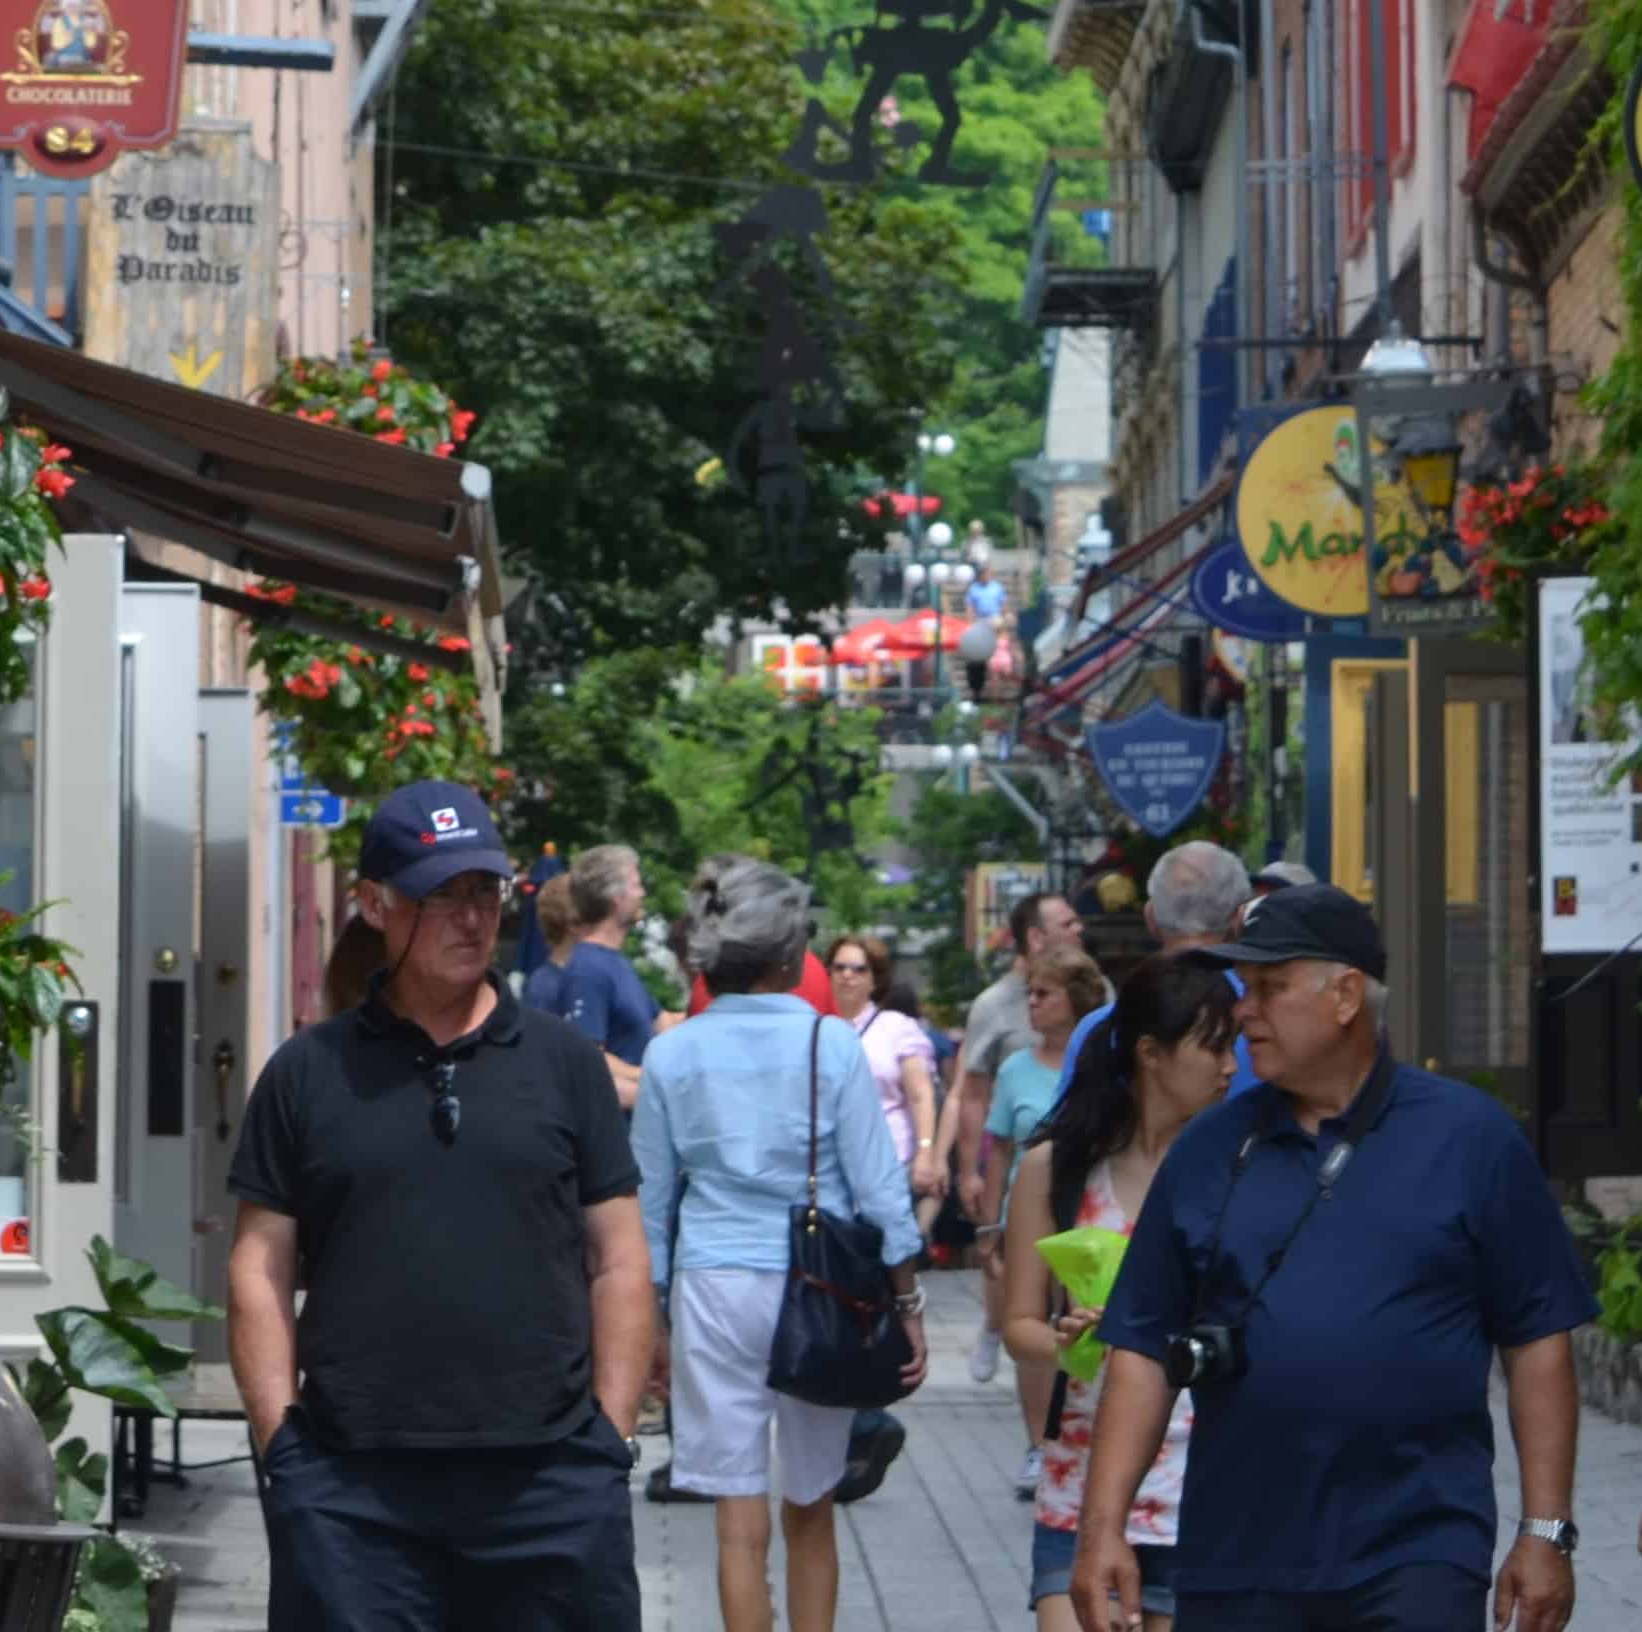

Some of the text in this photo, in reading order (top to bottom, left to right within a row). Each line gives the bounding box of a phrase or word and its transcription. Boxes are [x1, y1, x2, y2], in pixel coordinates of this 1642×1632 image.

[5, 86, 133, 107] CHOCOLATERIE
[111, 193, 255, 225] L'Oiseau
[165, 227, 201, 252] du
[117, 254, 241, 286] Paradis
